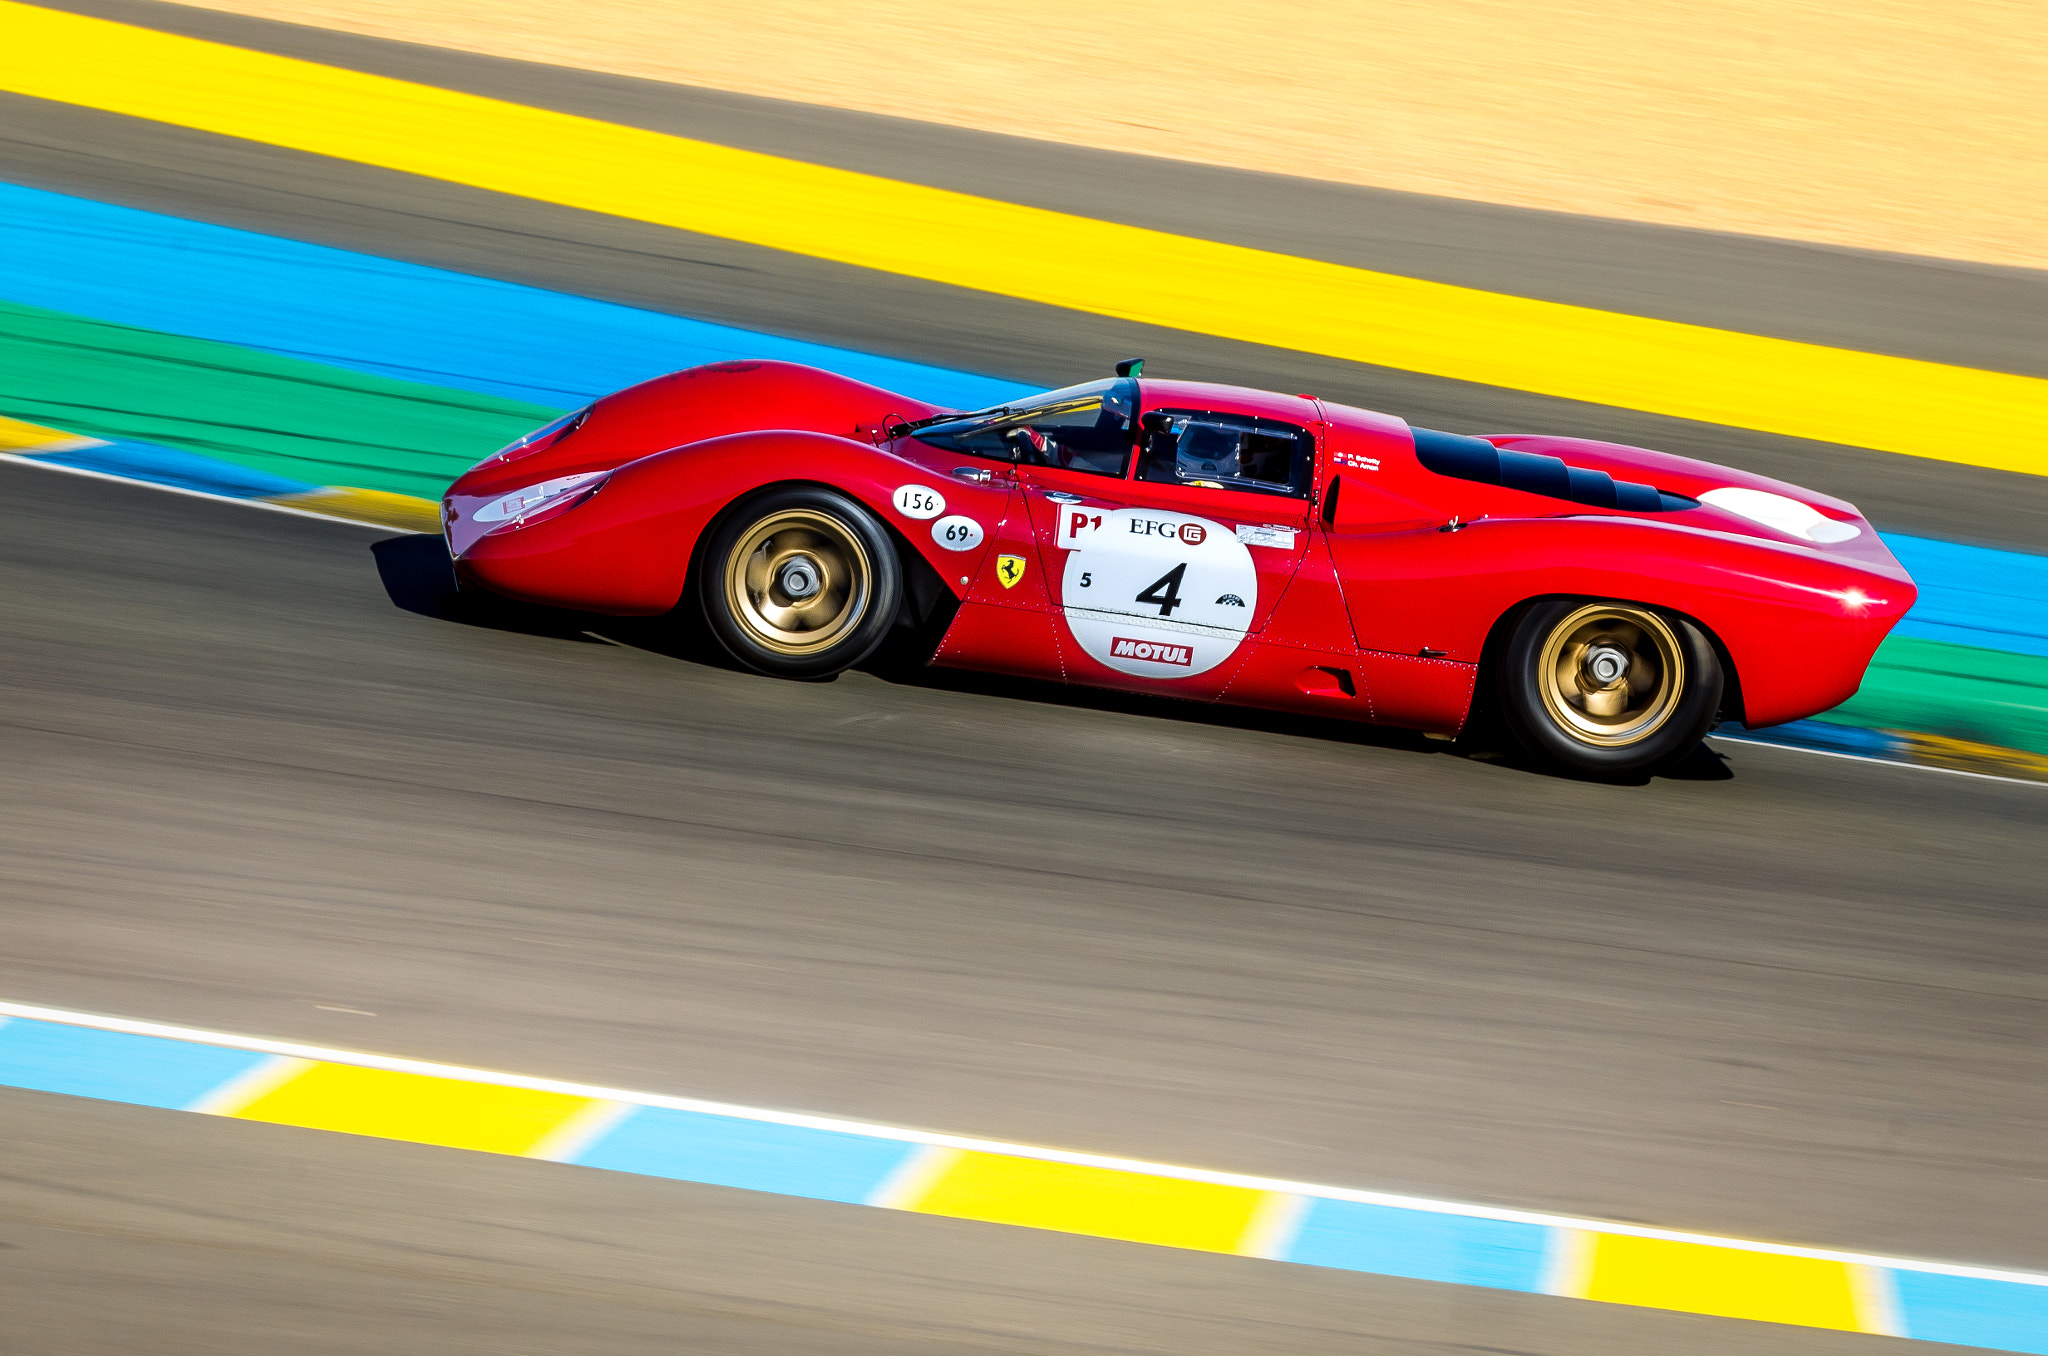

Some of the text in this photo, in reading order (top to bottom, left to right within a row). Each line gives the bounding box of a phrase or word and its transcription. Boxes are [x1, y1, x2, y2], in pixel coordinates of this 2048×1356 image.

[903, 492, 934, 511] 156
[946, 524, 969, 542] 69
[1129, 517, 1177, 539] EFG
[1079, 572, 1092, 588] 5
[1135, 562, 1188, 616] 4
[1113, 640, 1189, 664] MOTUL
